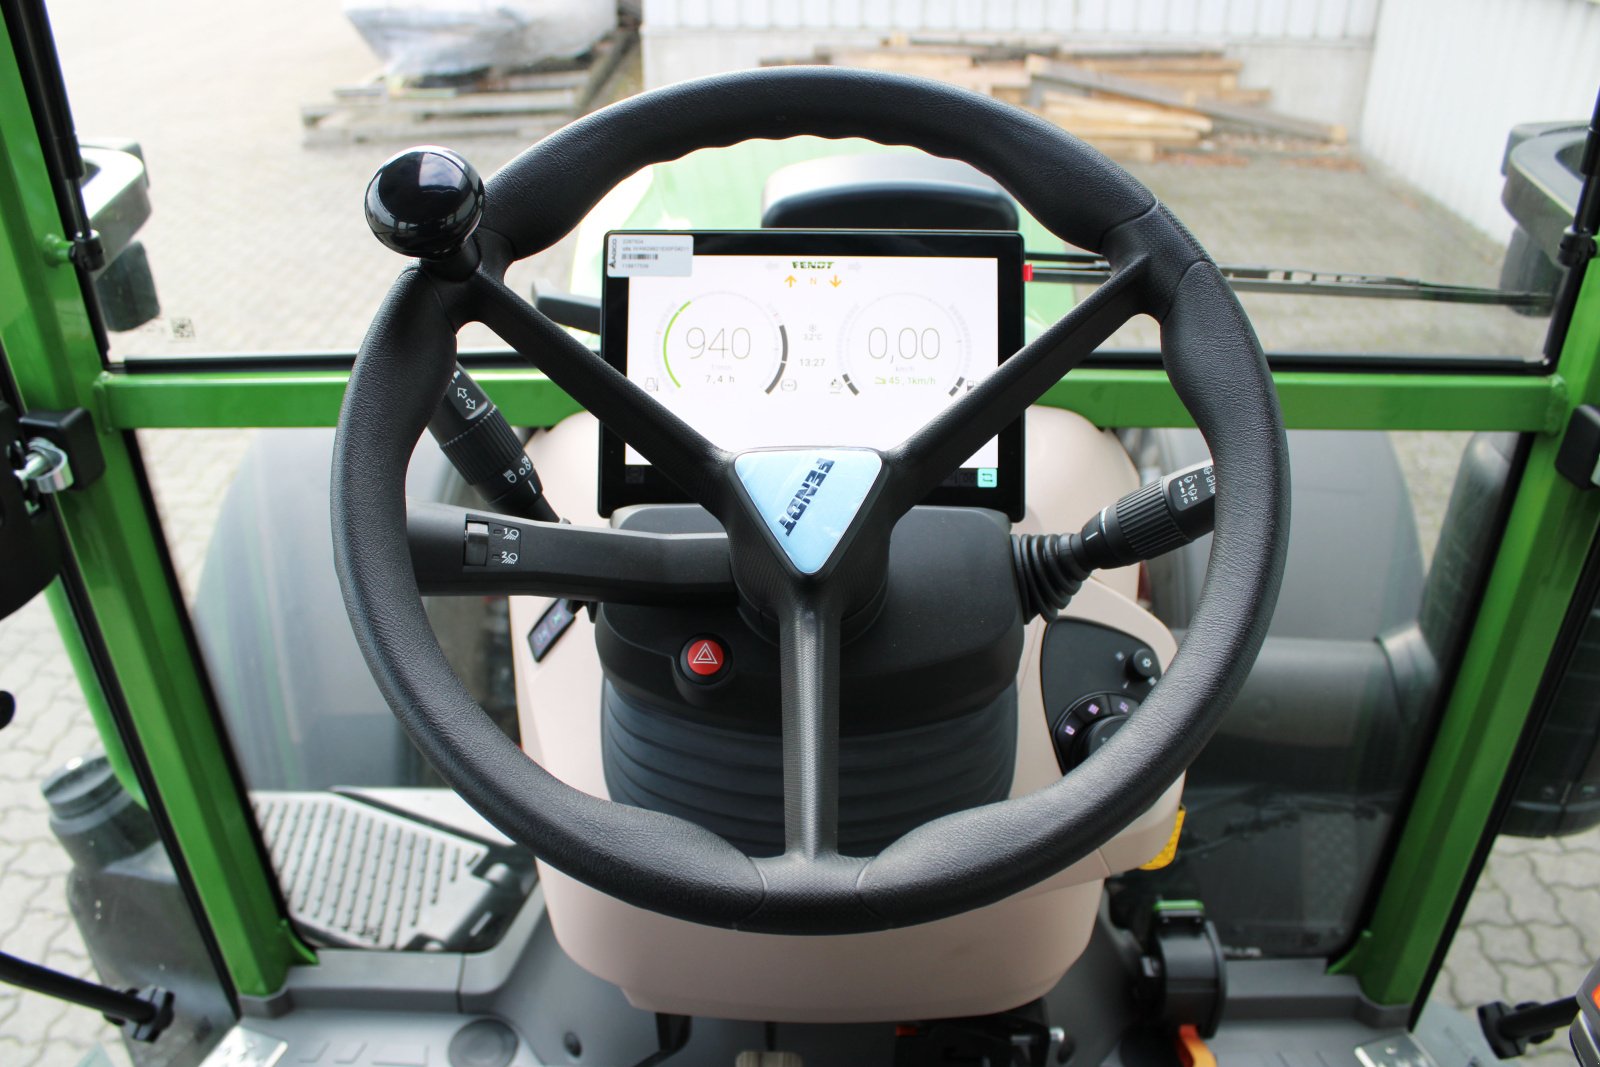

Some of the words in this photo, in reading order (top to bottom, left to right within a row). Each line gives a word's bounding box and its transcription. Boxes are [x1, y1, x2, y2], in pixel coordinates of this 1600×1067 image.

[792, 261, 835, 269] FENDT
[809, 277, 817, 285] N
[686, 327, 751, 360] 940
[868, 327, 940, 364] 0,00
[799, 358, 826, 367] 13:27
[778, 457, 835, 537] FENDT
